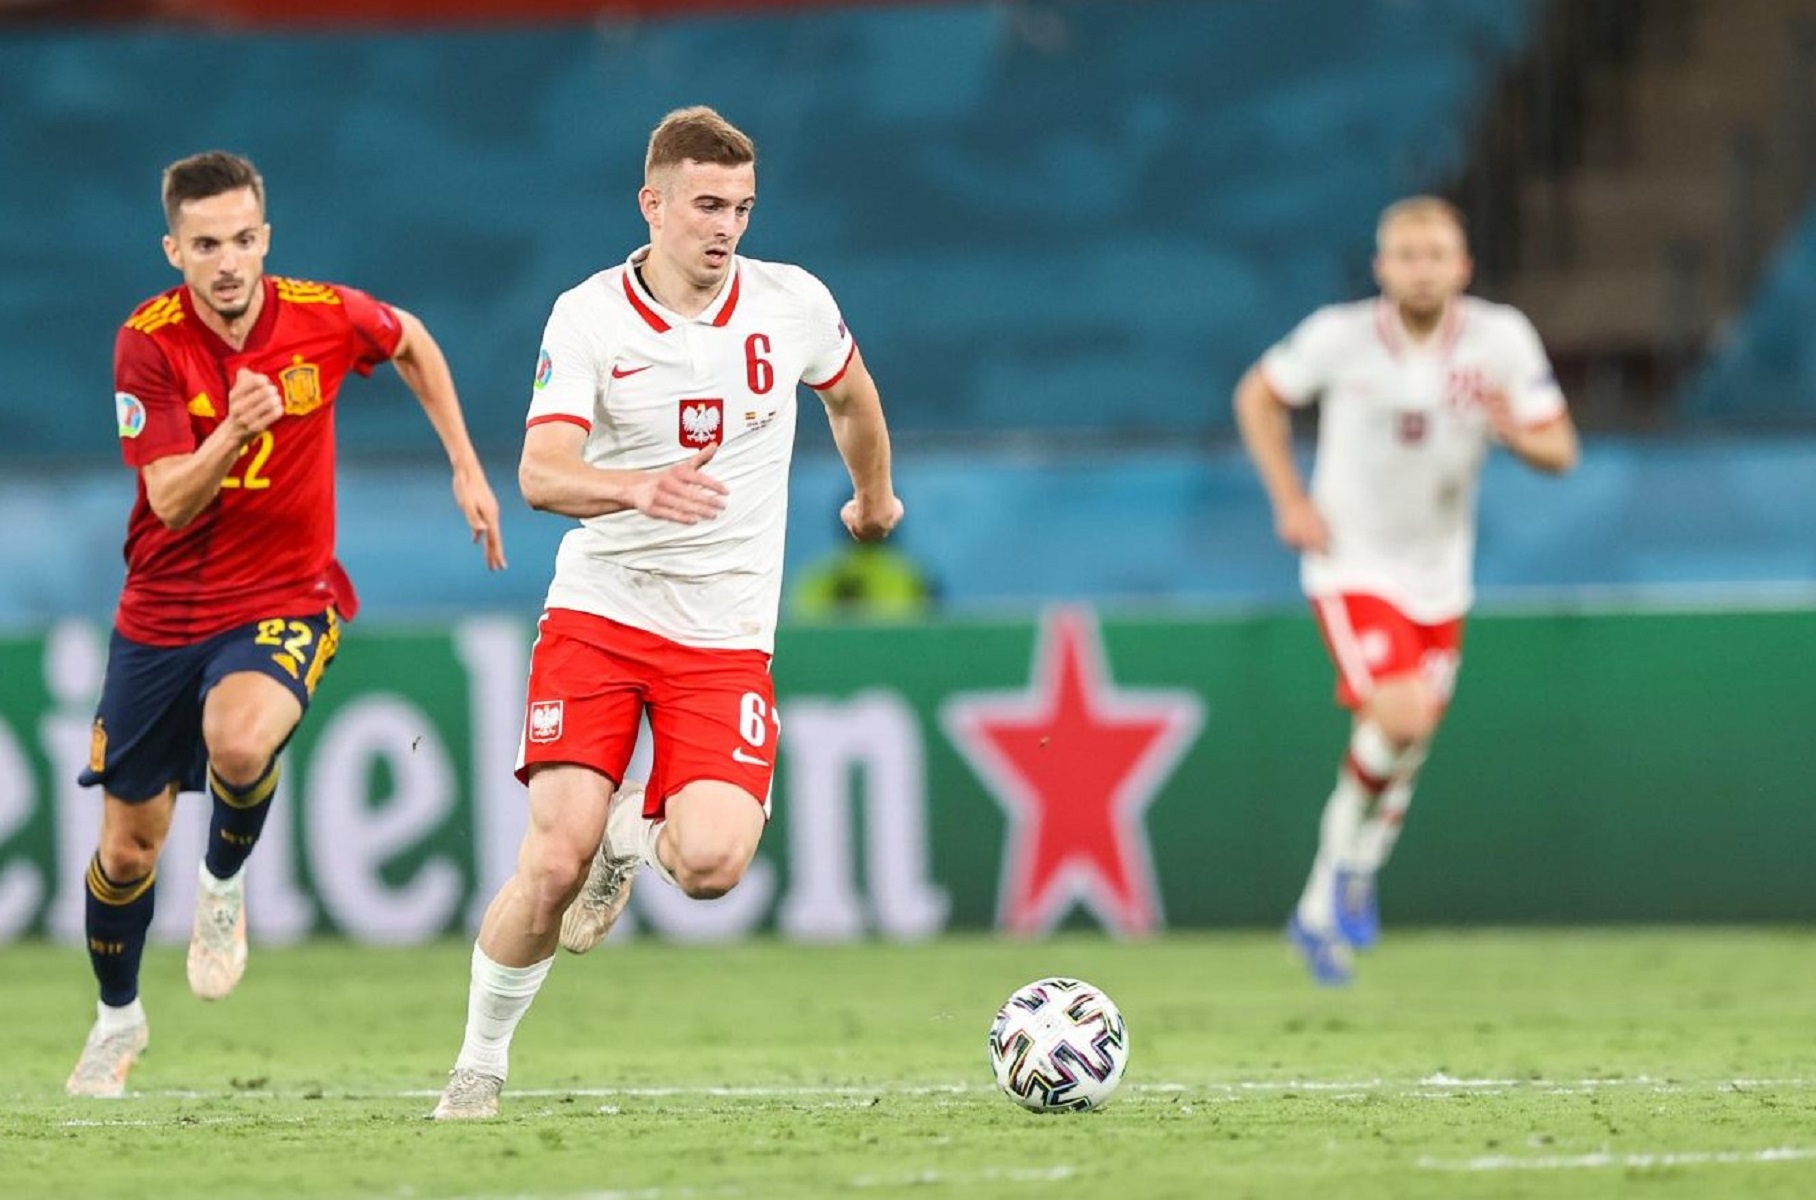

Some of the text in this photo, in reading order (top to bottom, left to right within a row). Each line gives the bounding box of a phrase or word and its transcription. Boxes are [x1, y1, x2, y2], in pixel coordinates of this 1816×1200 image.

[745, 334, 774, 394] 6
[255, 618, 312, 664] 22
[740, 692, 766, 747] 6
